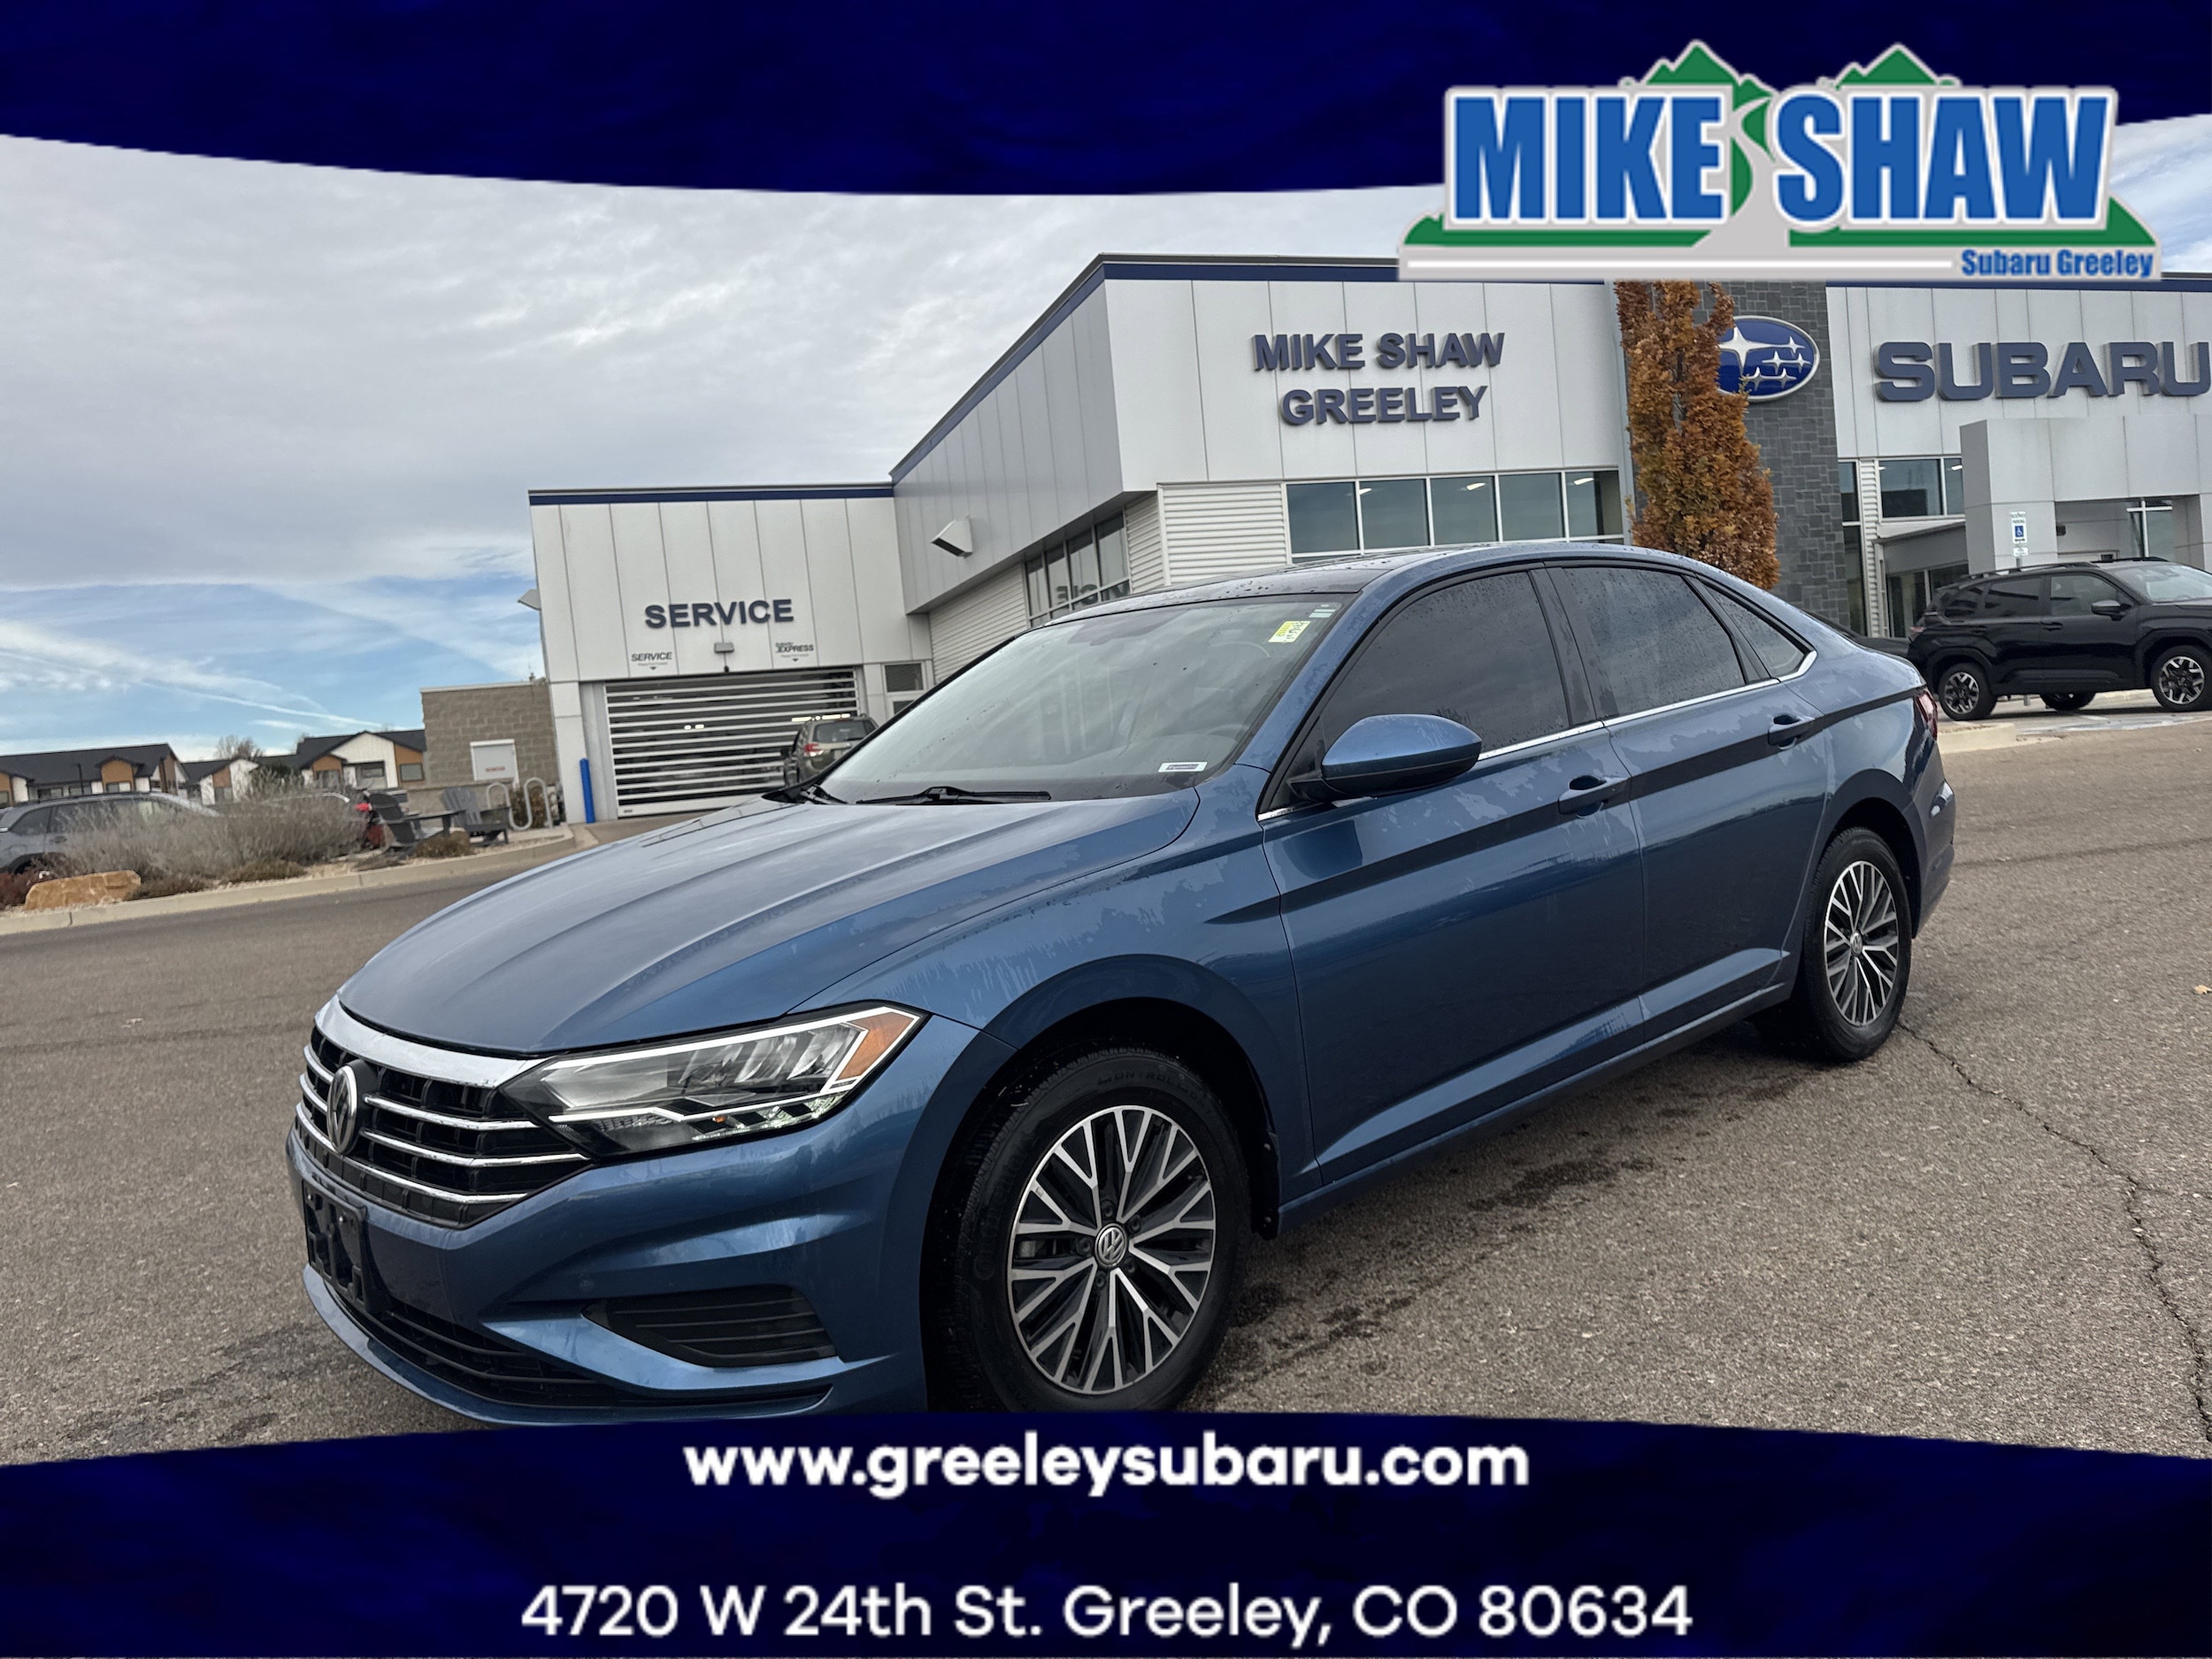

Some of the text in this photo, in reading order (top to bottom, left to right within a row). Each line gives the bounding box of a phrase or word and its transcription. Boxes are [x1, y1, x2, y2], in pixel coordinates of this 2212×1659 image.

[1253, 333, 1505, 372] MIKE SHAW
[1873, 341, 2211, 402] SUBARU
[1280, 385, 1488, 426] GREELEY
[645, 598, 795, 630] SERVICE
[631, 651, 672, 662] SERVICE
